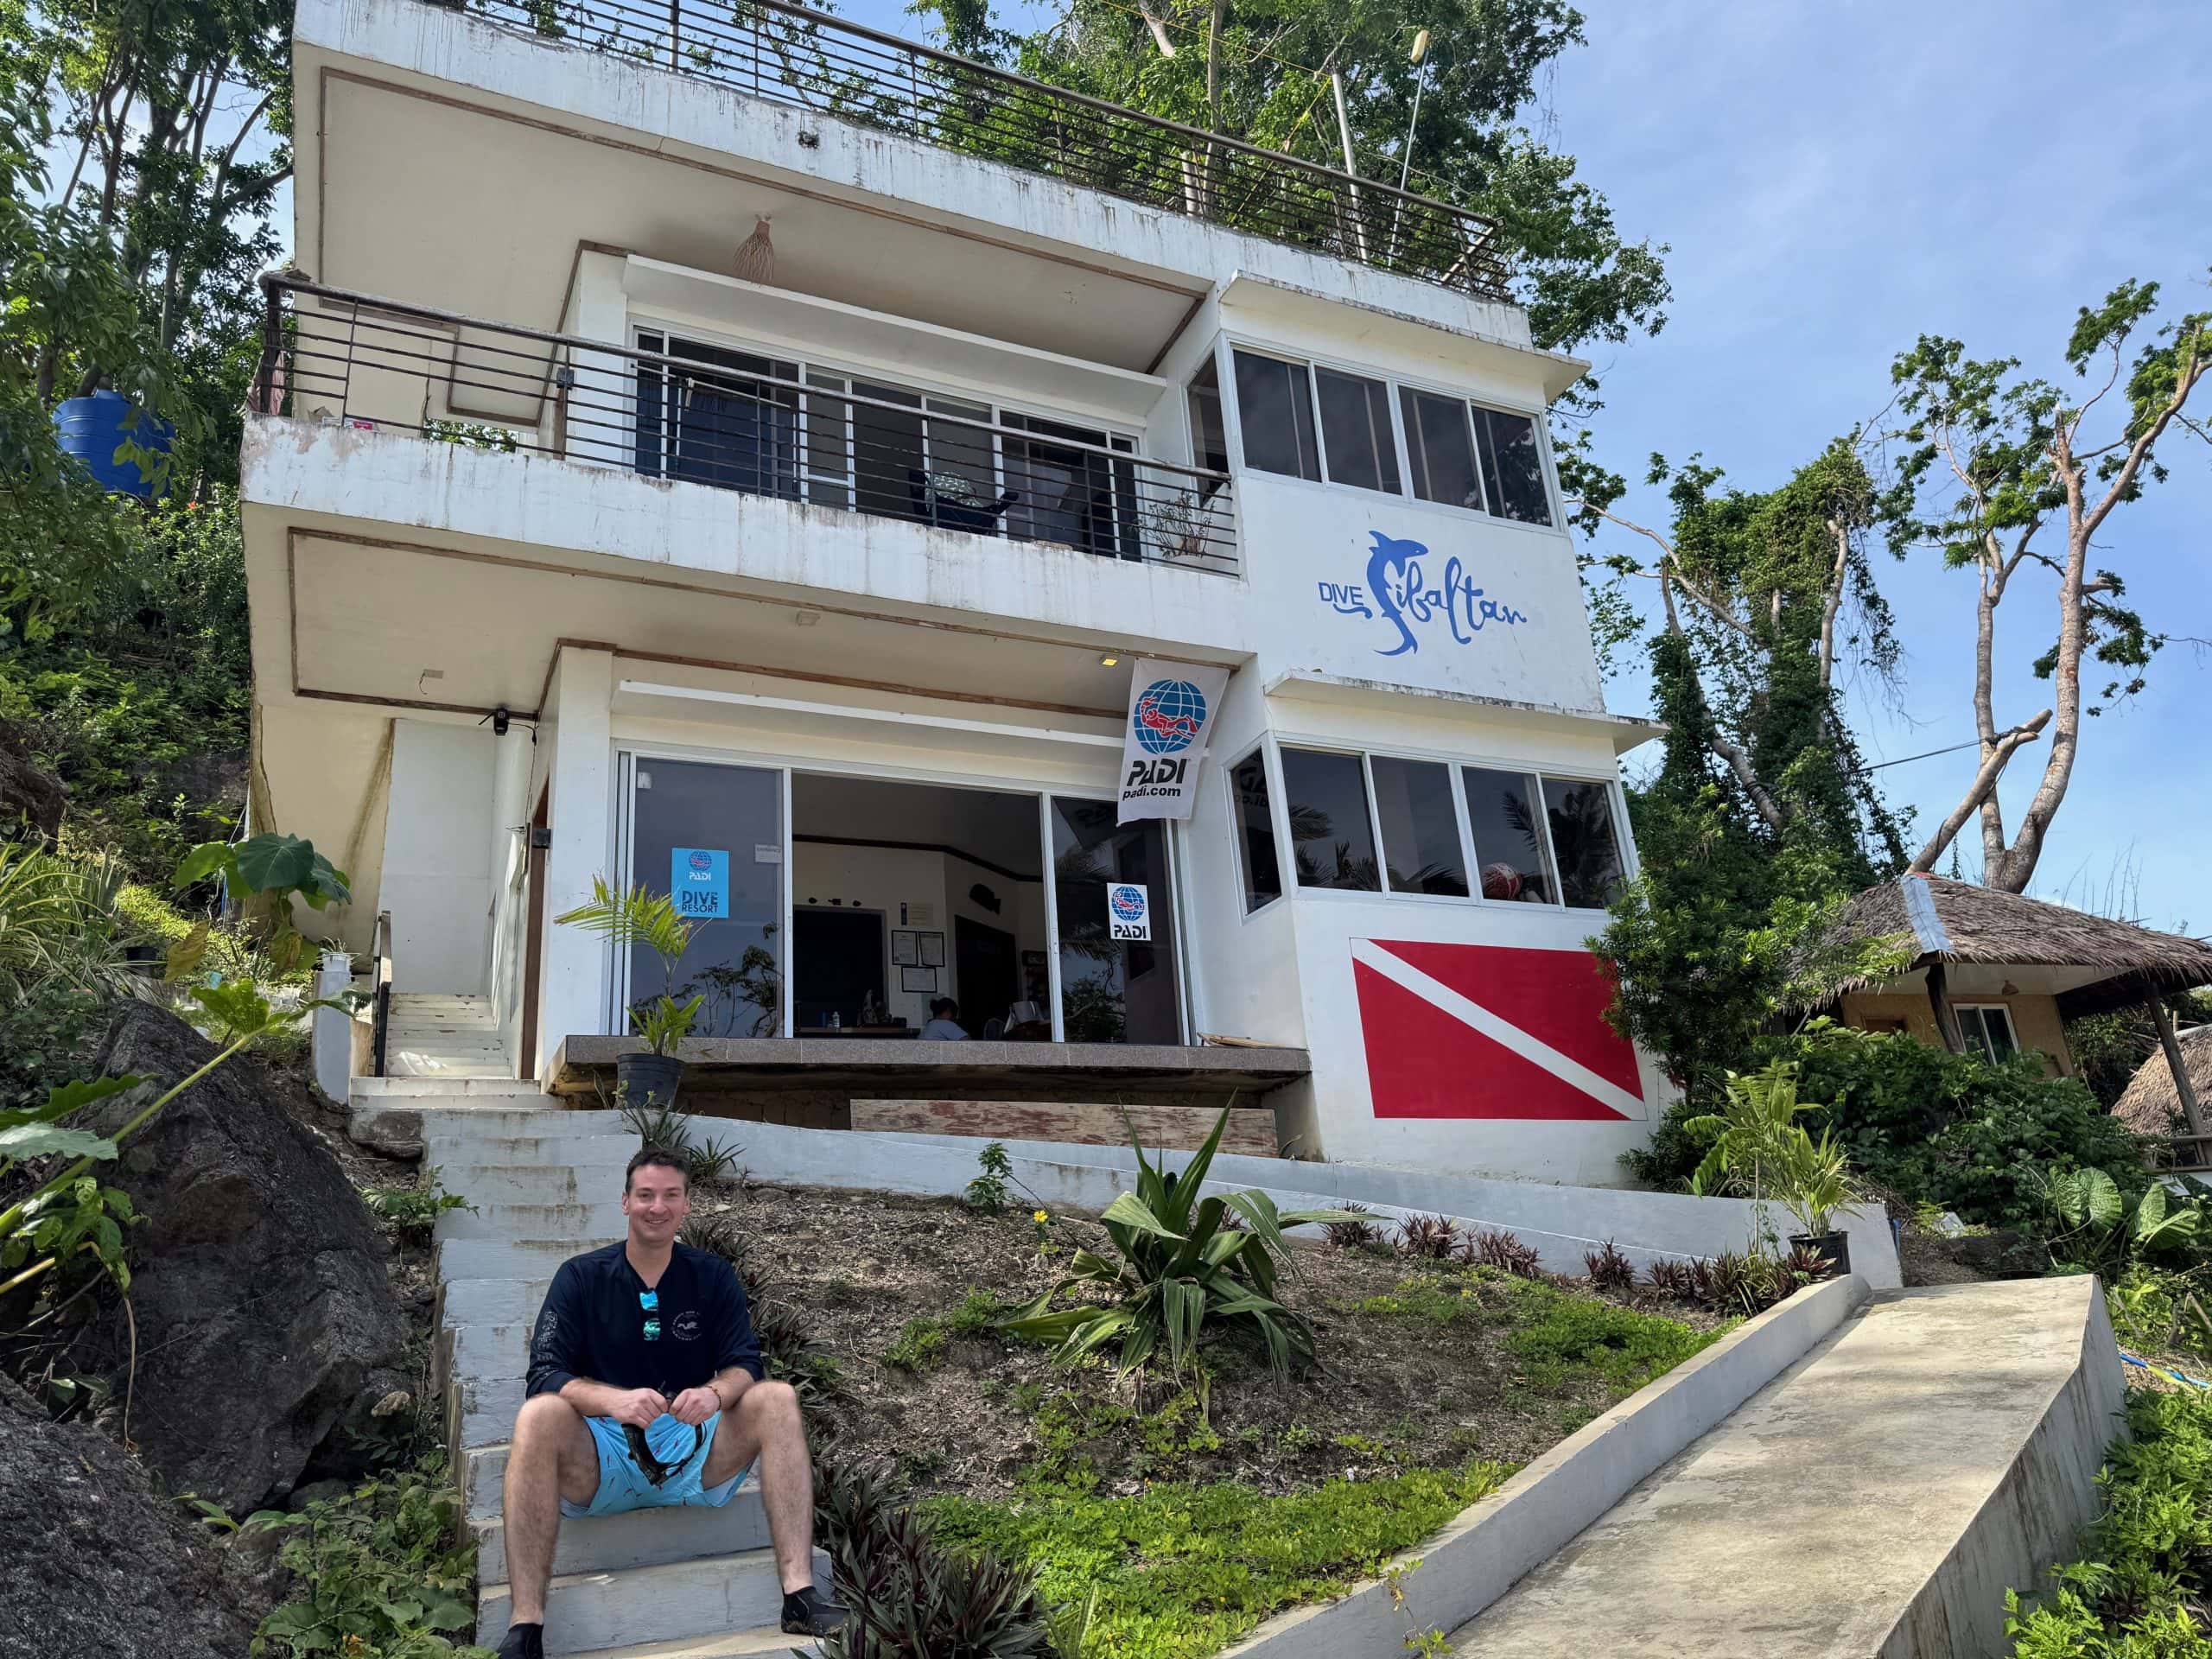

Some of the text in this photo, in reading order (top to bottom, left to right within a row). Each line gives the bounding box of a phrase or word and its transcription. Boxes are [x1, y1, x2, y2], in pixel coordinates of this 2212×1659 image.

[1318, 582, 1364, 606] DIVE
[1126, 758, 1189, 786] PADI
[1122, 785, 1181, 801] padi.com
[689, 871, 712, 880] PADI
[682, 890, 718, 905] DIVE
[682, 904, 719, 913] RESORT
[1113, 924, 1147, 939] PADI
